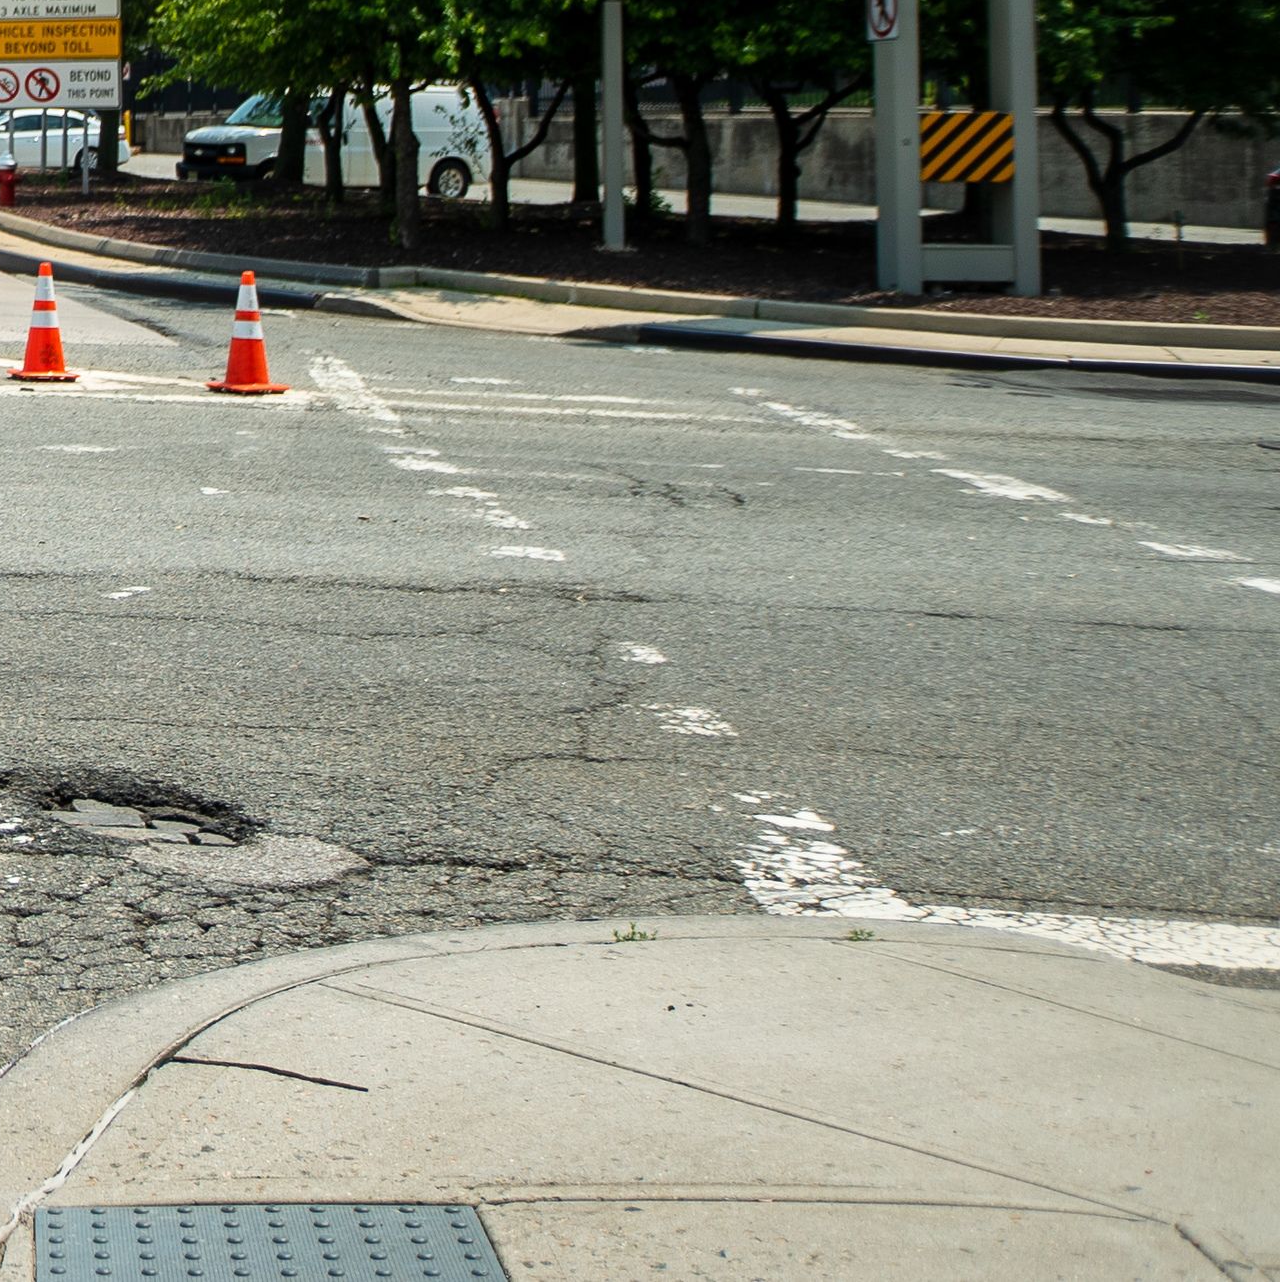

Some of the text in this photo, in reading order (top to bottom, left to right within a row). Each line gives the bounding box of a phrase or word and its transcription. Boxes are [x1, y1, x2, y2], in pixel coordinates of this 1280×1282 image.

[0, 4, 96, 17] 3 AXLE MAXIMUM
[41, 23, 117, 37] INSPECTION
[4, 41, 93, 54] BEYOND TOLL
[69, 69, 112, 82] BEYOND
[67, 87, 115, 98] THIS POINT
